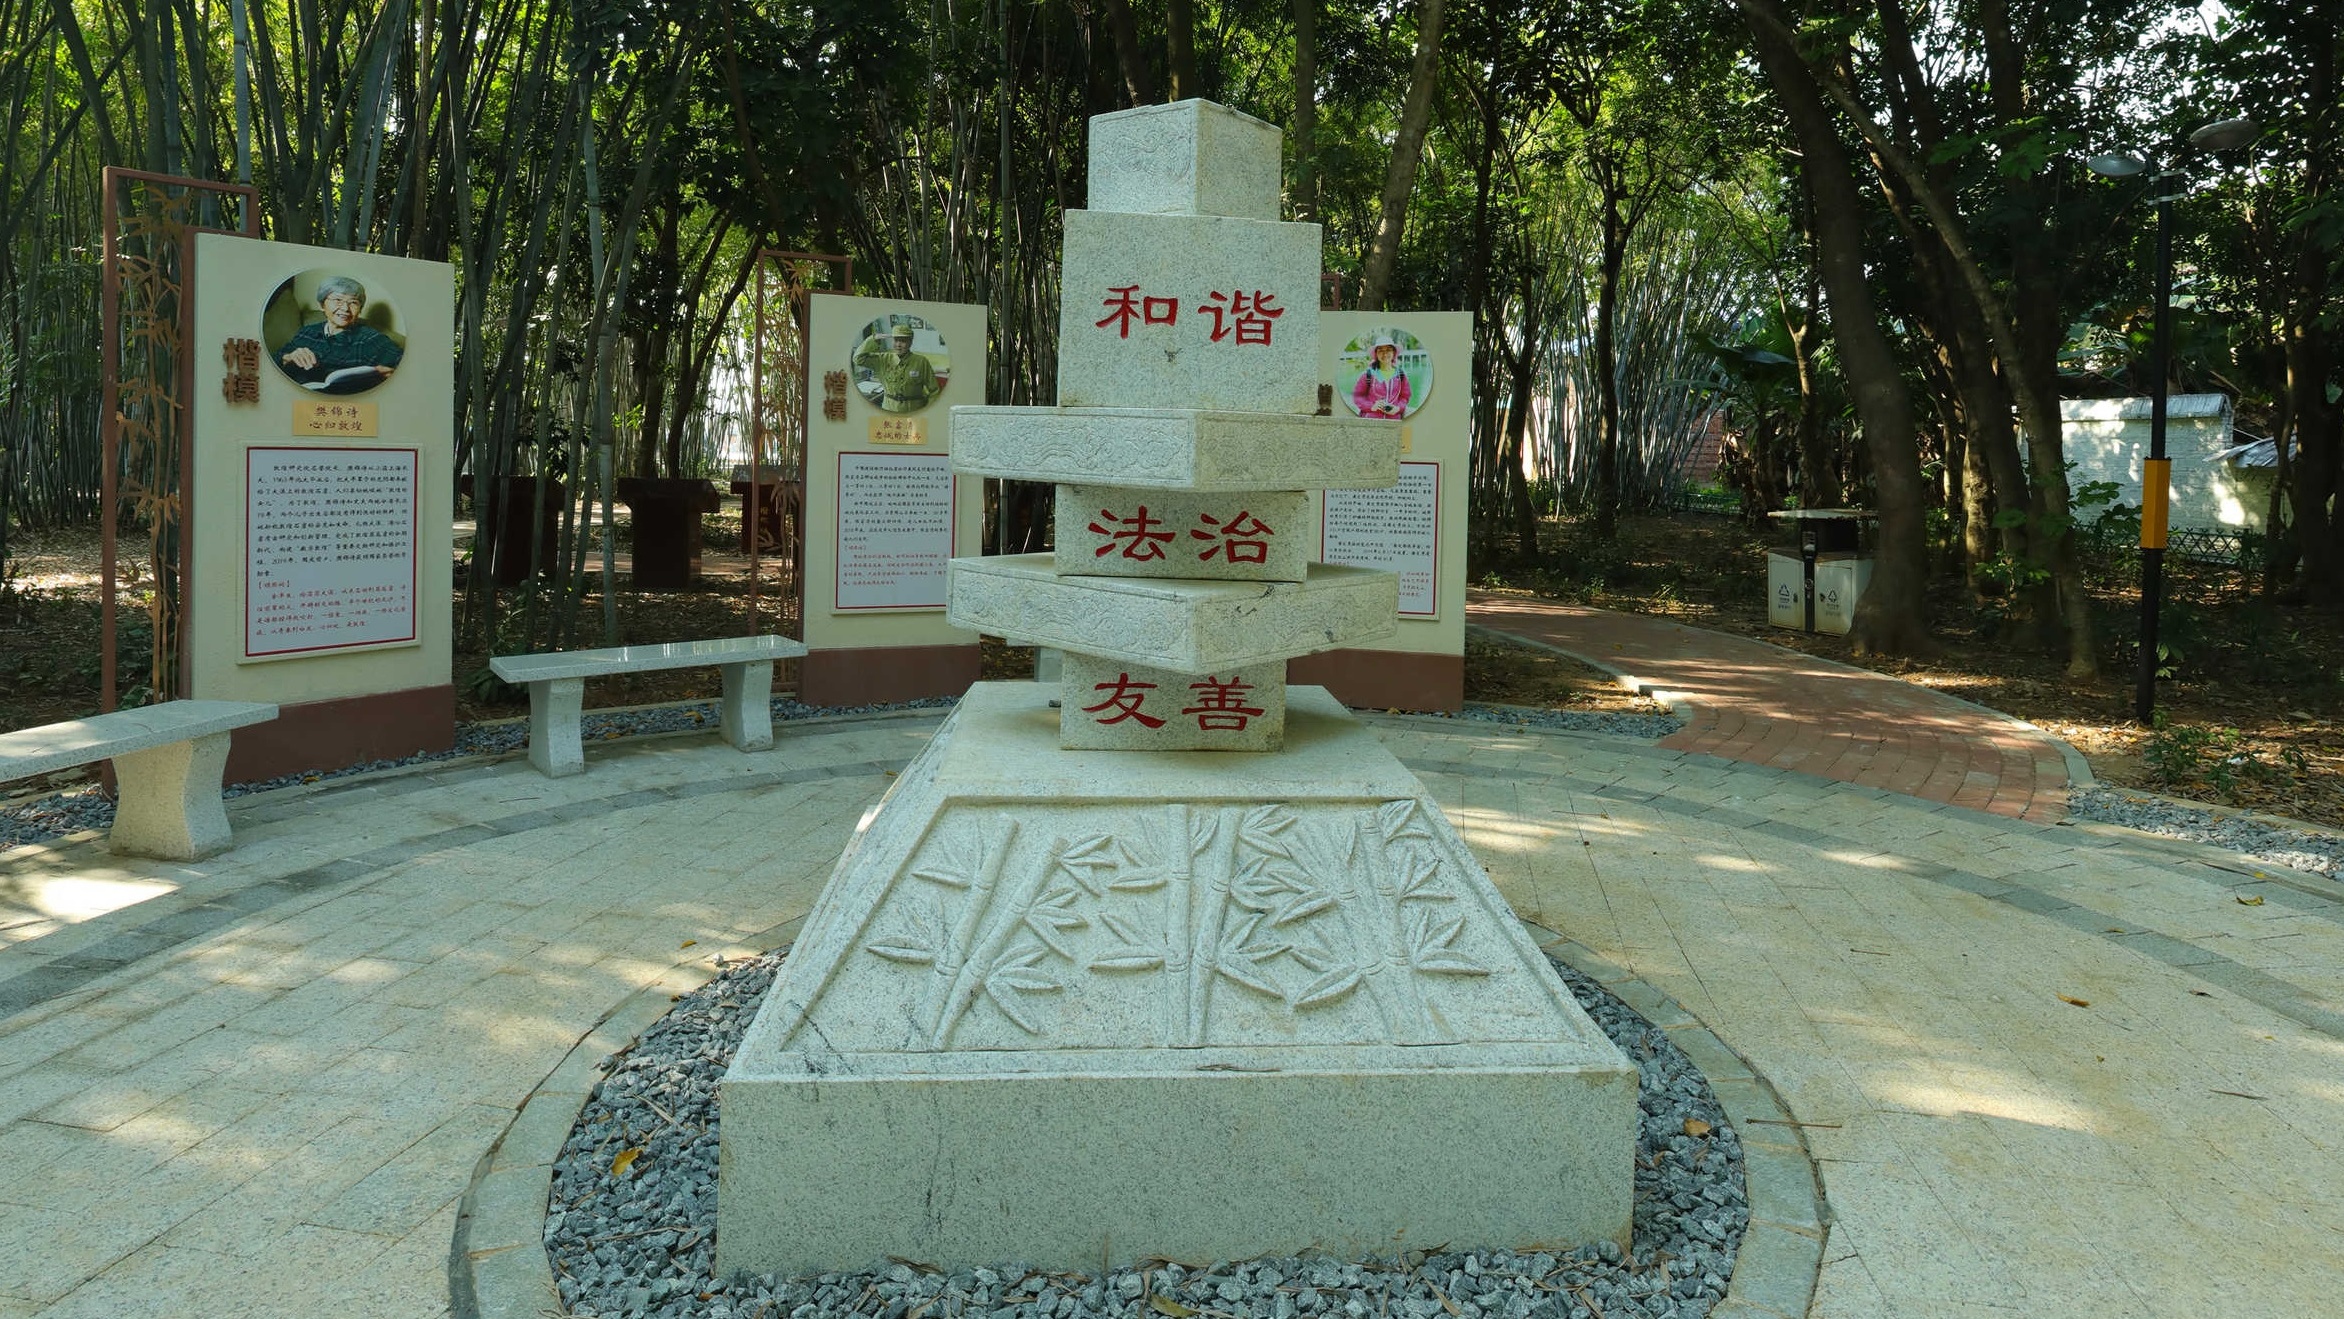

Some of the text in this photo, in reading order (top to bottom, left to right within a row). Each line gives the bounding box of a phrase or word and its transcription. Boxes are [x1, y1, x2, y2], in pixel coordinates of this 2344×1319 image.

[1096, 285, 1284, 346] 和谐
[223, 338, 261, 402] 楷模
[314, 406, 359, 418] 樊锦诗
[1089, 506, 1274, 564] 法治
[1082, 671, 1265, 731] 友善
